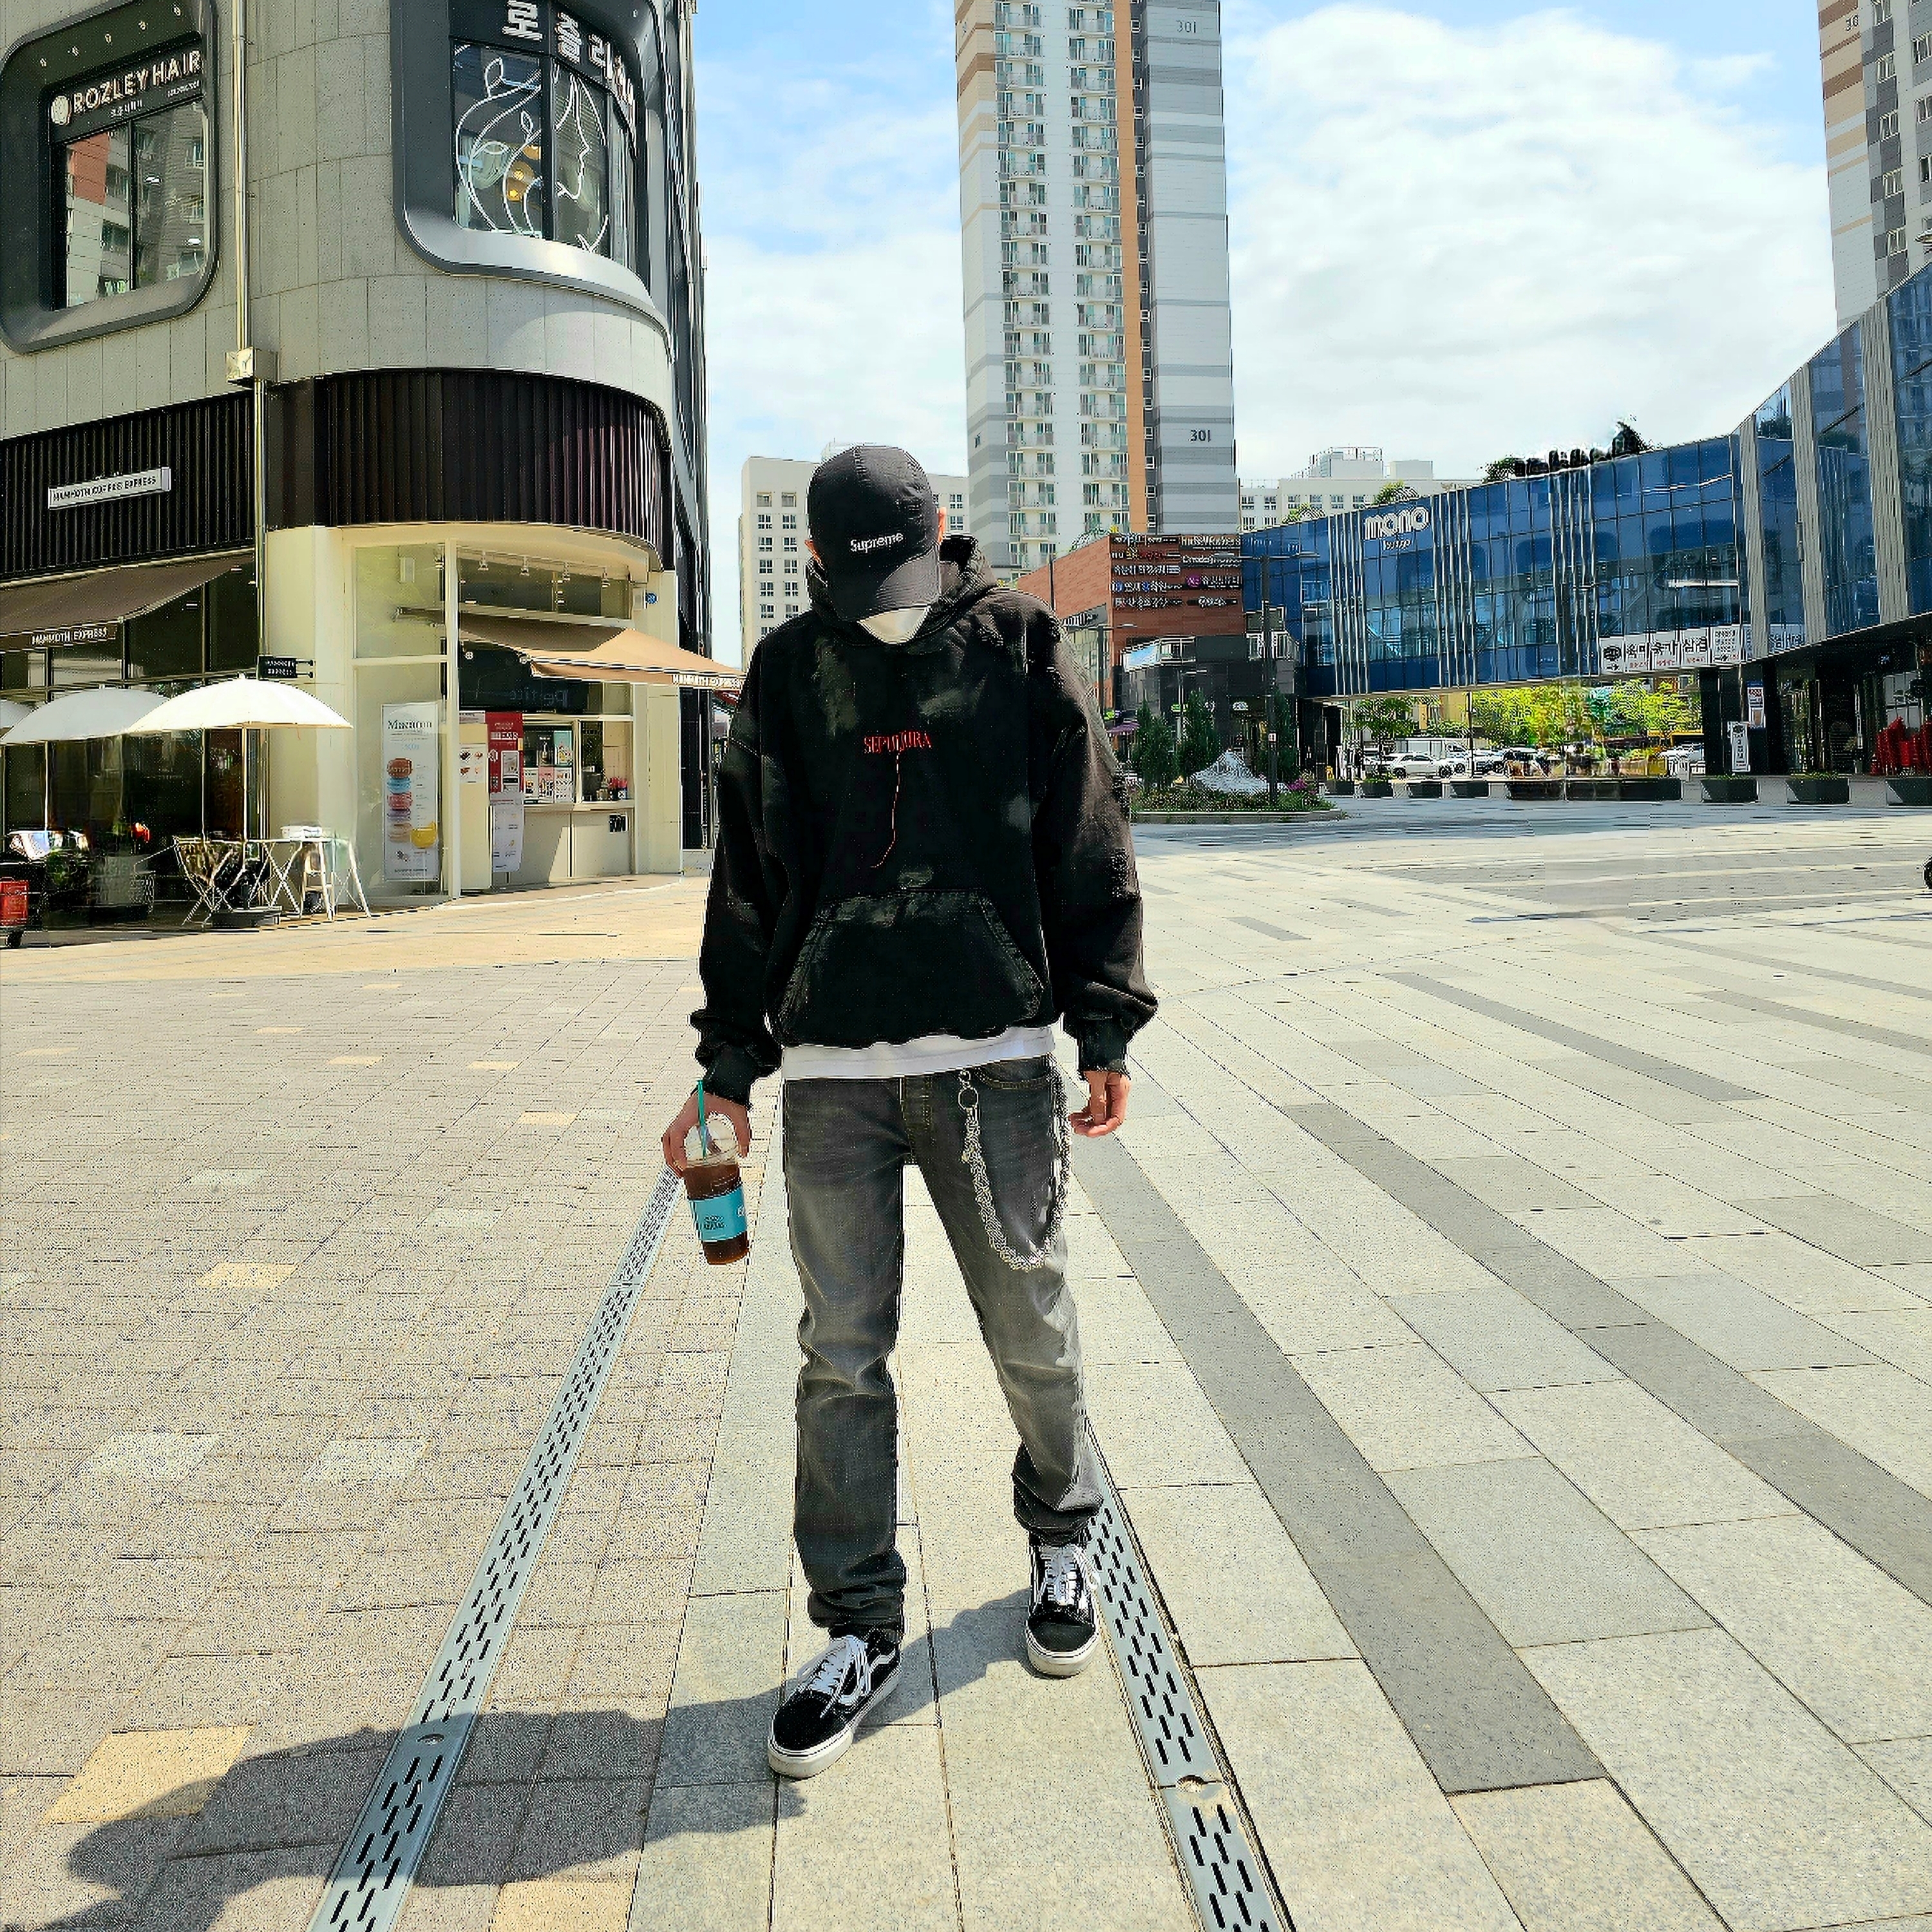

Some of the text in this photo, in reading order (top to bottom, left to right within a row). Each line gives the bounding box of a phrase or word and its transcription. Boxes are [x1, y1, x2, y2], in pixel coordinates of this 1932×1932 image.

[73, 68, 149, 114] ROZLEY
[153, 50, 201, 86] HAIR
[1190, 430, 1211, 443] 301
[850, 533, 904, 553] Supreme
